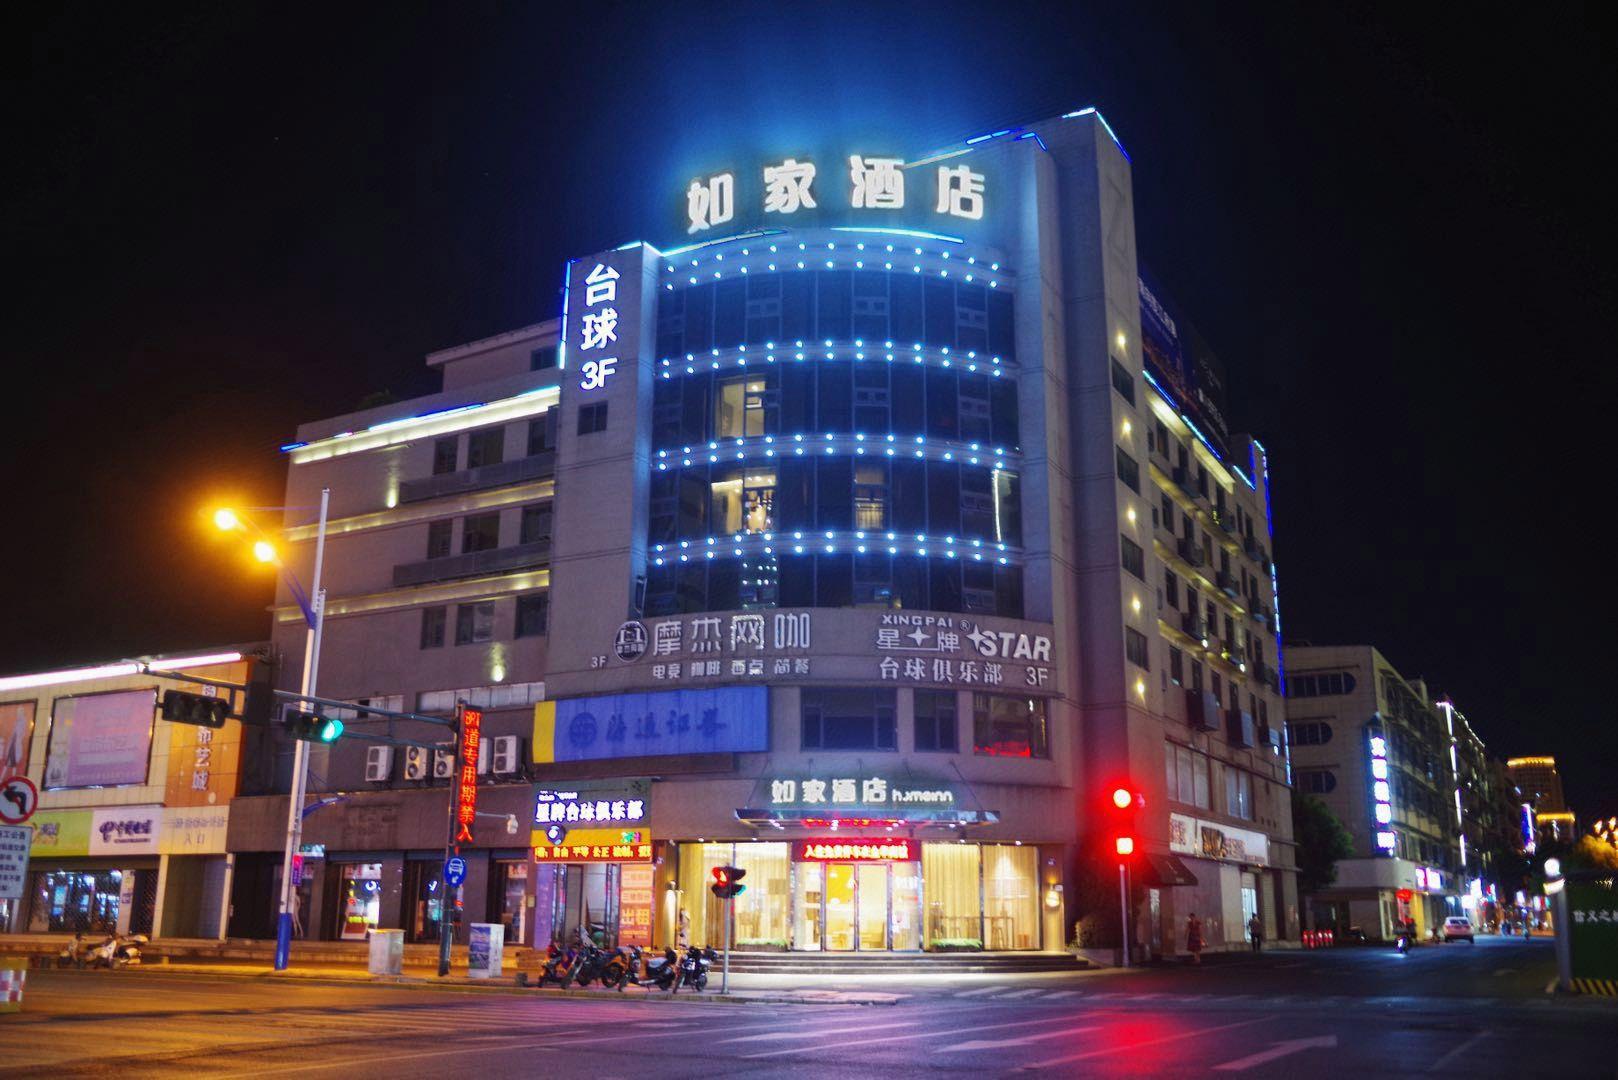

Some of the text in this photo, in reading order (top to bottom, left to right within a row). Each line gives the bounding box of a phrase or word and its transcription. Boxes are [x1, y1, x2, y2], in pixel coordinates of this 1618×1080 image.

[687, 155, 985, 234] 如家酒店
[580, 263, 621, 390] 台球 3F
[653, 612, 810, 656] 摩杰网咖
[882, 614, 953, 628] XINGPAI
[979, 630, 1052, 662] STAR
[591, 655, 607, 669] 3F
[652, 664, 682, 680] 电竞
[731, 659, 764, 676] 西点
[880, 656, 1003, 685] 台球俱乐部
[1026, 665, 1049, 687] 3F
[771, 777, 888, 803] 如家酒店
